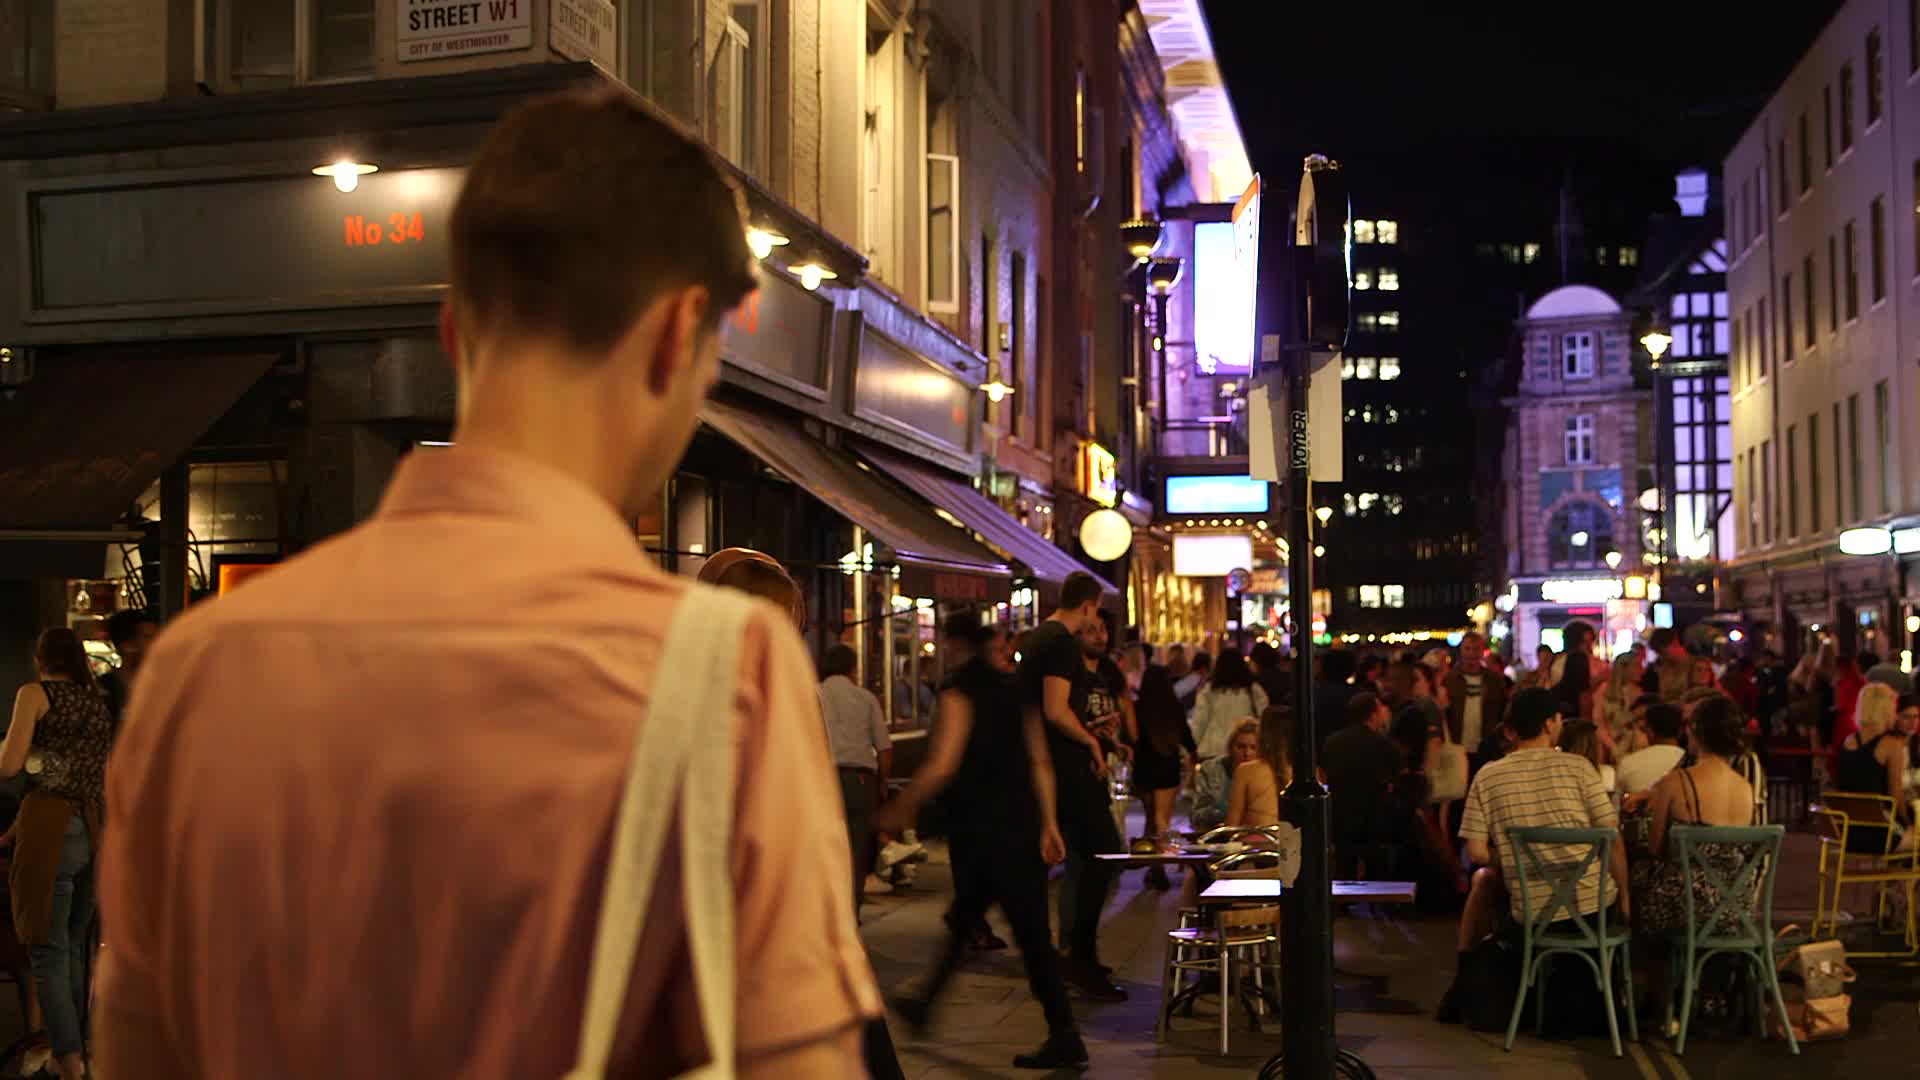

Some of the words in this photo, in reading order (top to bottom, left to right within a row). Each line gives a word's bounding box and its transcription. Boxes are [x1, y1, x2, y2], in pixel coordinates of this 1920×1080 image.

[409, 3, 481, 31] STREET
[488, 0, 518, 22] W1
[409, 40, 430, 55] CITY
[432, 39, 443, 52] OF
[446, 33, 511, 50] WESTMINSTER
[343, 215, 382, 247] No
[388, 211, 424, 243] 34
